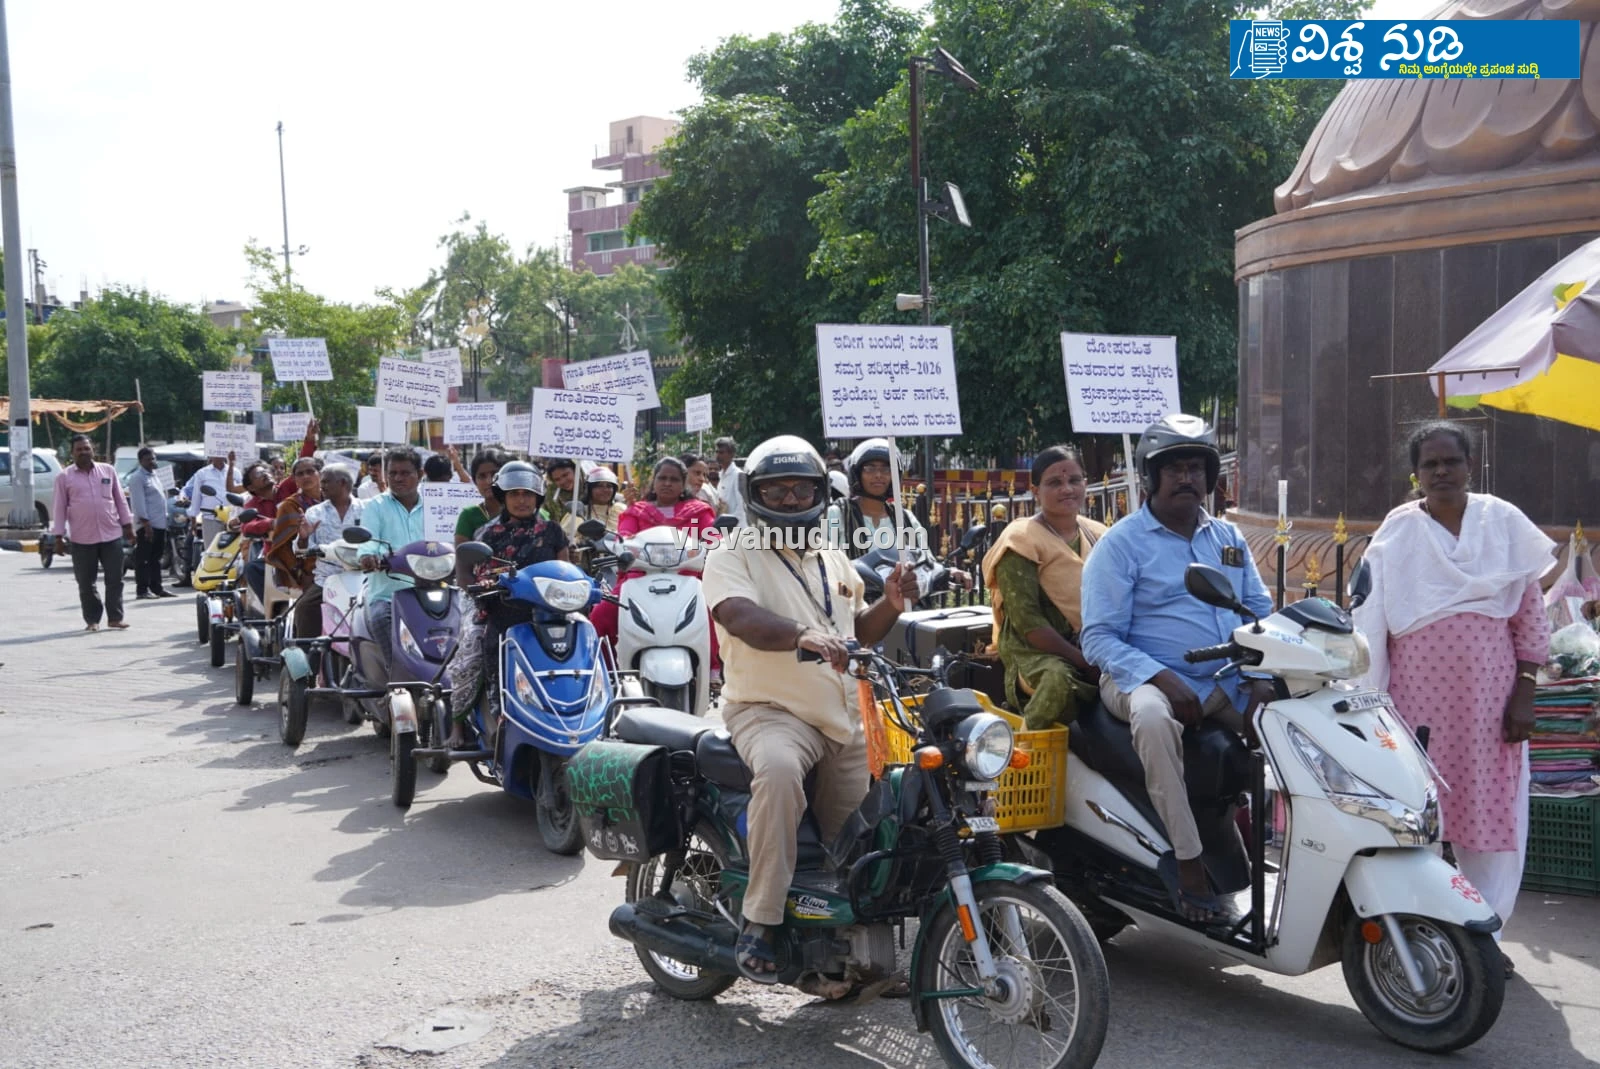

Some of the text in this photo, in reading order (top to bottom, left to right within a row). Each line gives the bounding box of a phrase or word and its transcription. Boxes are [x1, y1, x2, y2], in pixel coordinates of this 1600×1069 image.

[1086, 338, 1152, 355] ದೋಷರಹಿತ
[834, 361, 864, 381] ಸಮಗ್ರ
[1069, 361, 1125, 377] ಮತದಾರರ
[553, 391, 617, 406] ಗಣತಿದಾರರ
[545, 408, 624, 430] ನಮೂನೆಯನ್ನು
[829, 414, 857, 428] ಒಂದು
[892, 413, 919, 427] ಒಂದು
[924, 413, 957, 426] ಗುರುತು
